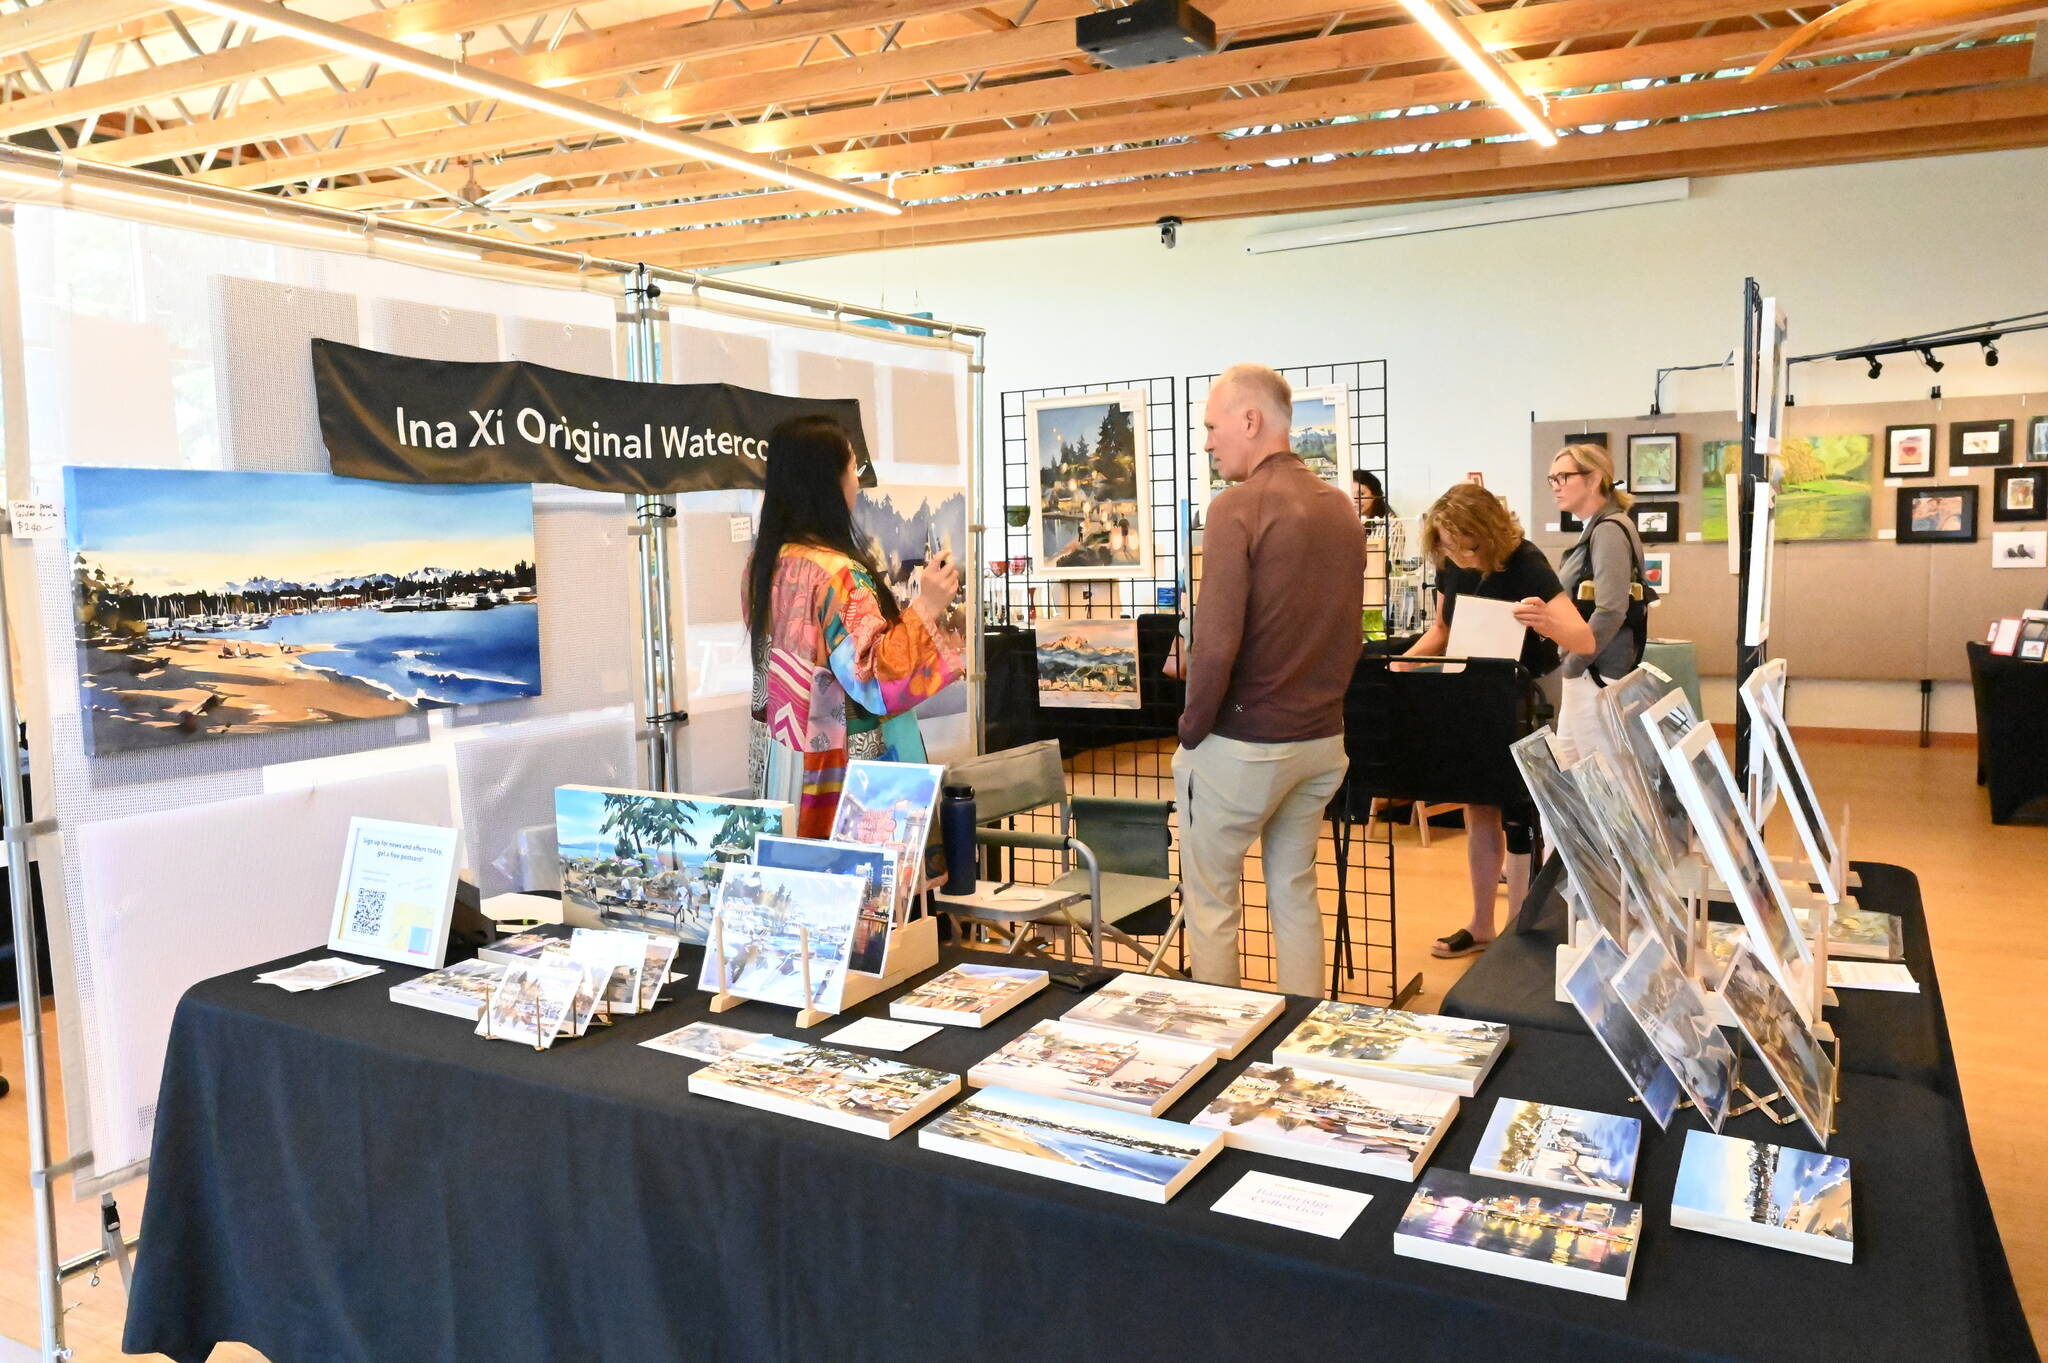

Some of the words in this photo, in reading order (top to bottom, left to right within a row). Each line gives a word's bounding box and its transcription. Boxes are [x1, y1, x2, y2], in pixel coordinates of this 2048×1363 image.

[396, 406, 457, 449] Ina
[468, 409, 505, 448] Xi
[516, 406, 652, 463] Original
[660, 425, 769, 462] Waterco
[363, 837, 374, 845] Sign
[1251, 1196, 1325, 1217] Collection
